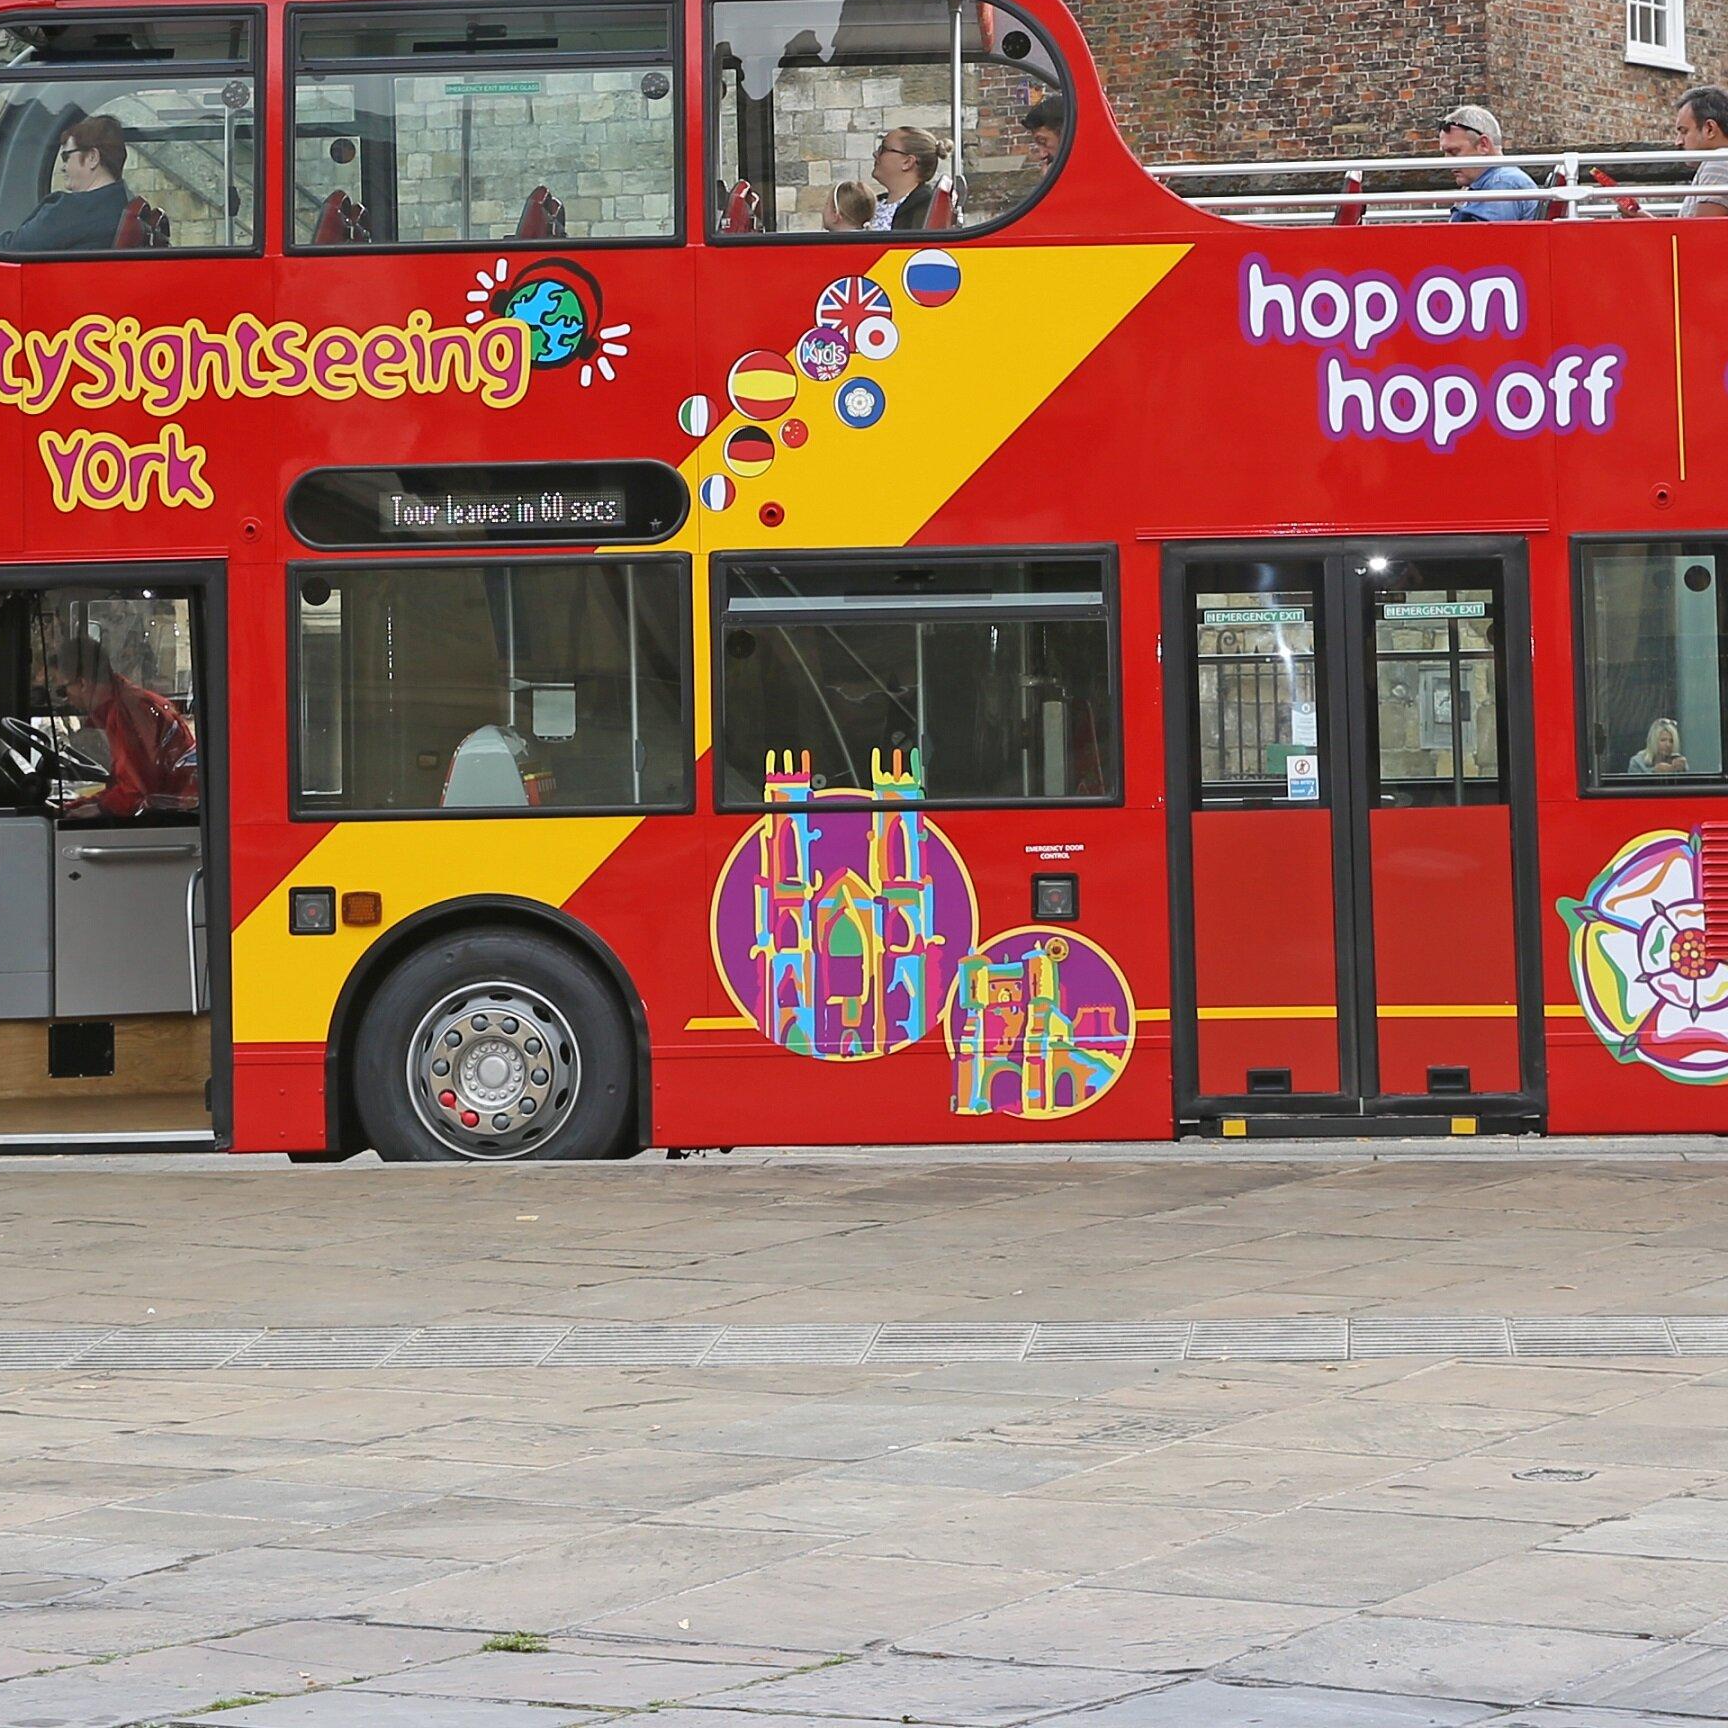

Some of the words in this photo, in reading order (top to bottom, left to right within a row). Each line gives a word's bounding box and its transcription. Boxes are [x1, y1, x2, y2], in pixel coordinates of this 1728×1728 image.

[1248, 263, 1399, 350] hop
[1415, 276, 1519, 336] on
[802, 338, 848, 365] Kids
[1327, 358, 1479, 446] hop
[1494, 354, 1619, 432] off
[391, 495, 440, 526] Tour
[446, 494, 511, 524] leaves
[517, 495, 534, 523] in
[540, 492, 564, 522] 60
[570, 500, 617, 521] secs
[1216, 611, 1279, 622] EMERGENCY
[1279, 611, 1302, 620] EXIT
[1396, 605, 1459, 616] EMERGENCY
[1459, 604, 1482, 614] EXIT
[1025, 845, 1063, 853] EMERGENCY
[1040, 852, 1070, 860] CONTROL
